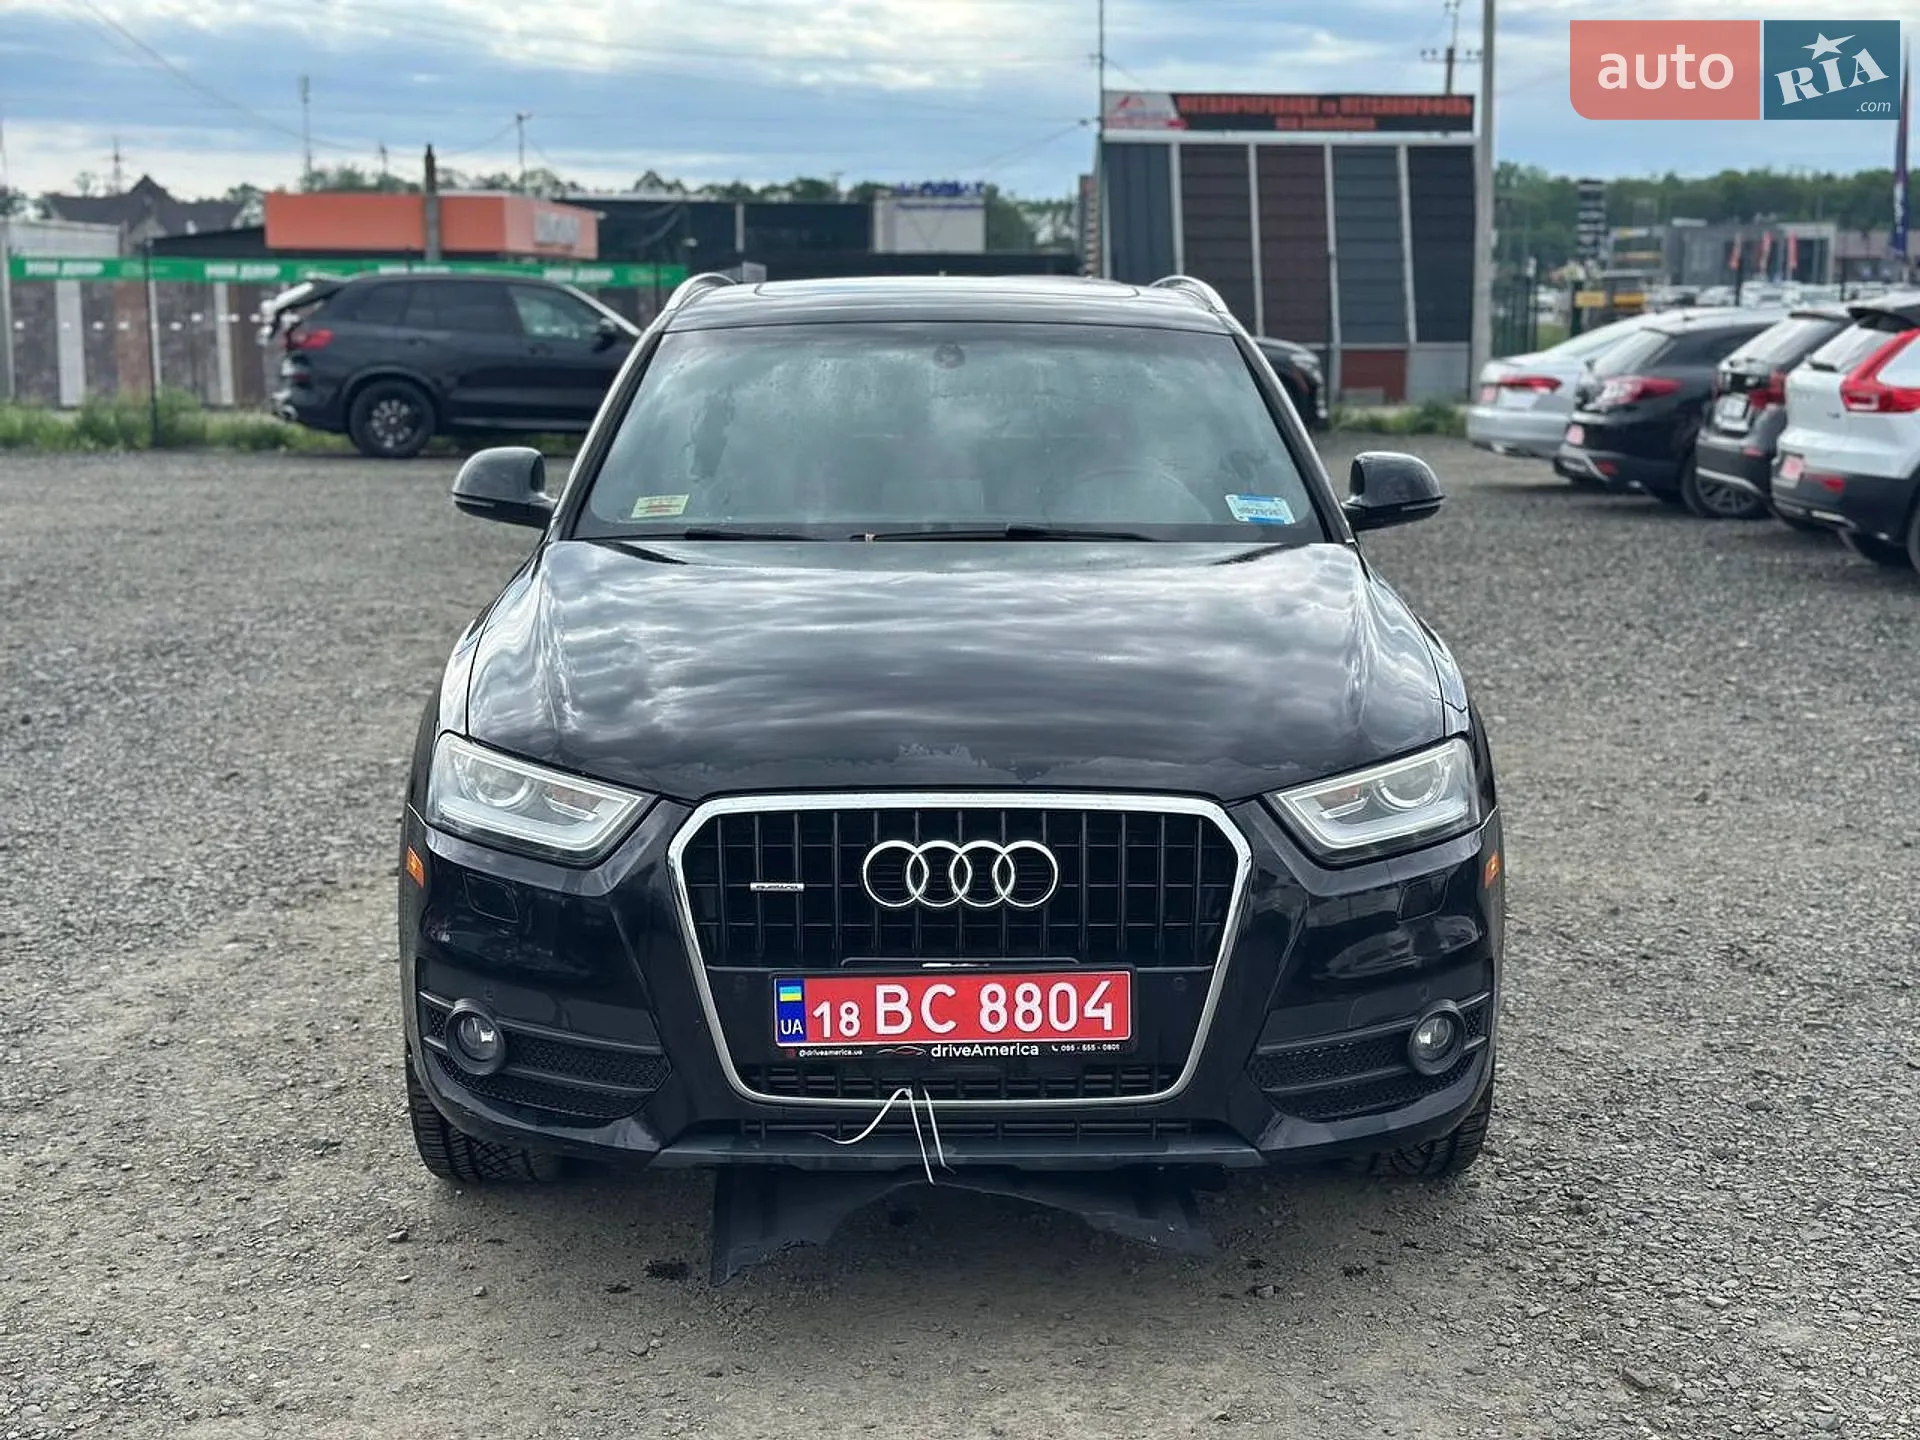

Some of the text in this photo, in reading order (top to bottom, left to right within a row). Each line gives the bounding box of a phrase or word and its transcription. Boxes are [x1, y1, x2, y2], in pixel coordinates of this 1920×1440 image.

[812, 980, 1113, 1038] 18 BC 8804
[780, 1019, 804, 1035] UA
[931, 1043, 1039, 1057] driveAmerica
